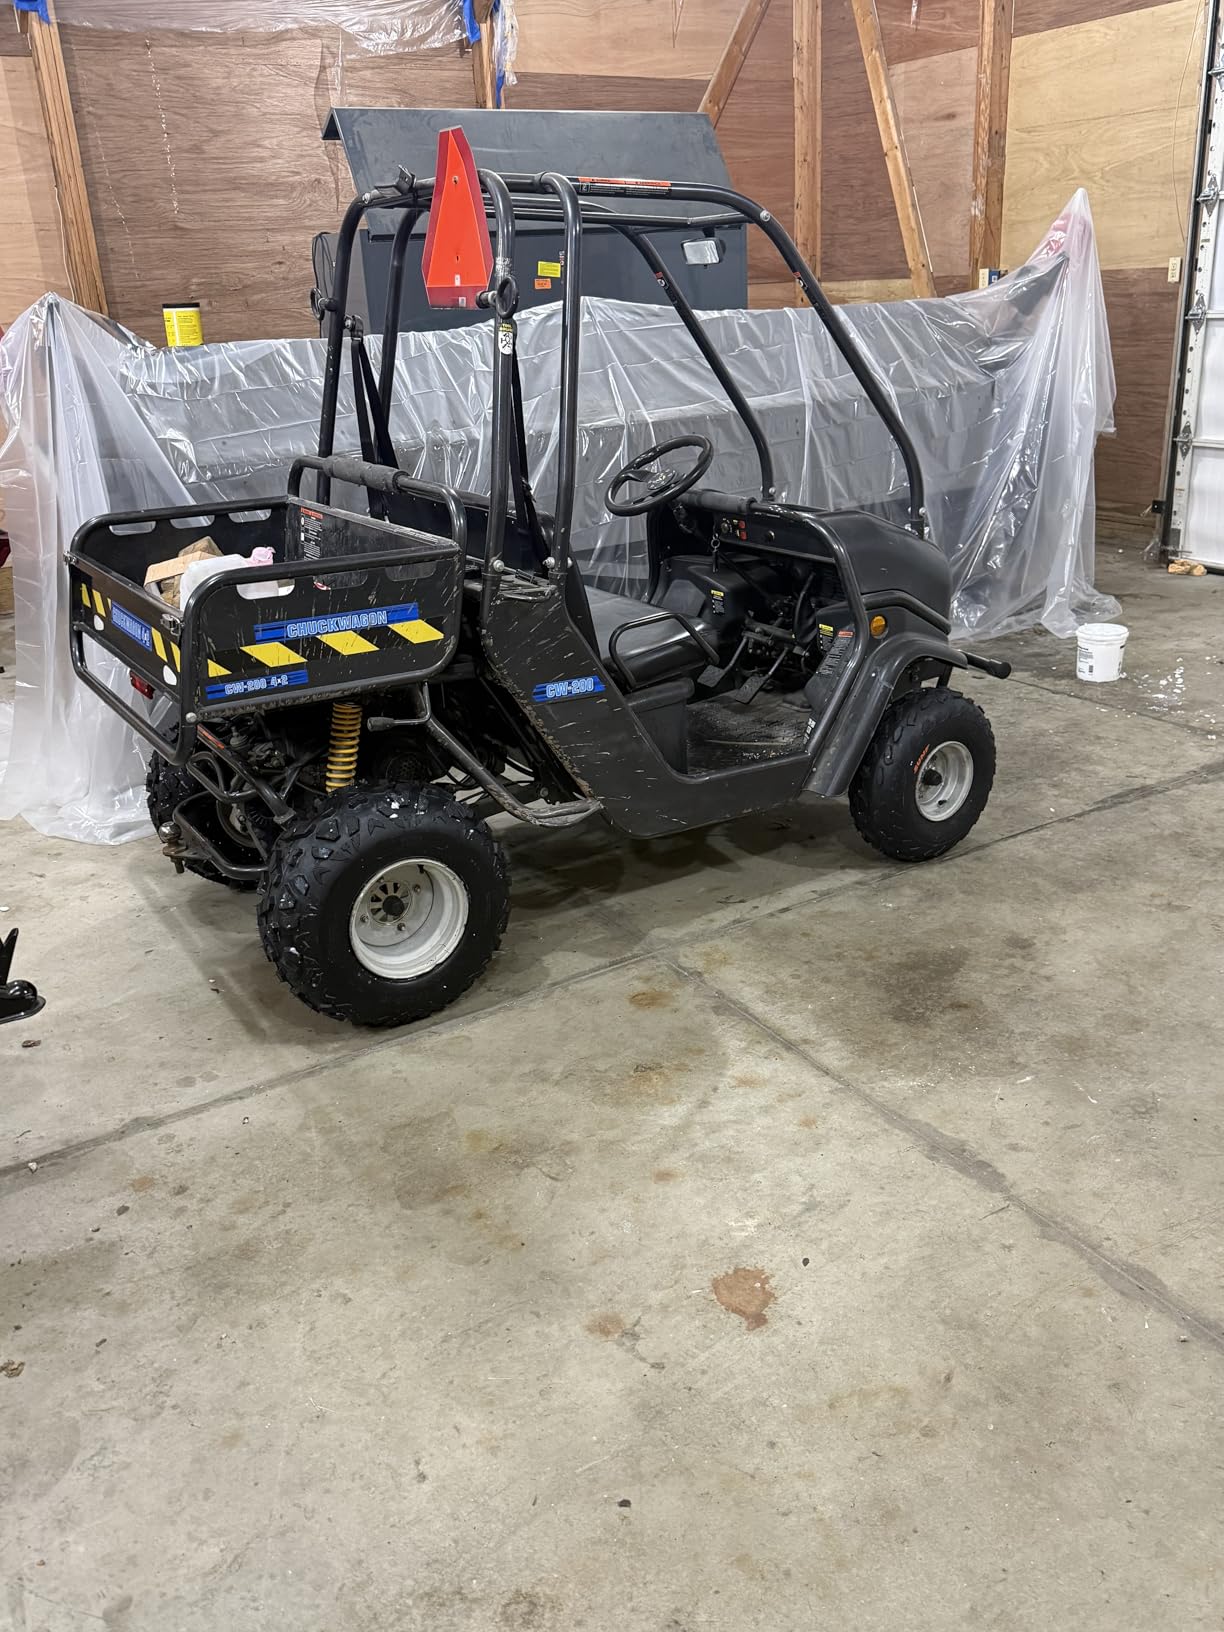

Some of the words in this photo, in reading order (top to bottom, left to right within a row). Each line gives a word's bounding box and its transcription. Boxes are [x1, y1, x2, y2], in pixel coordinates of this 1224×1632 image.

[286, 610, 388, 638] CHUCKWAGON
[224, 678, 267, 695] CW-200
[546, 677, 594, 698] CW-200
